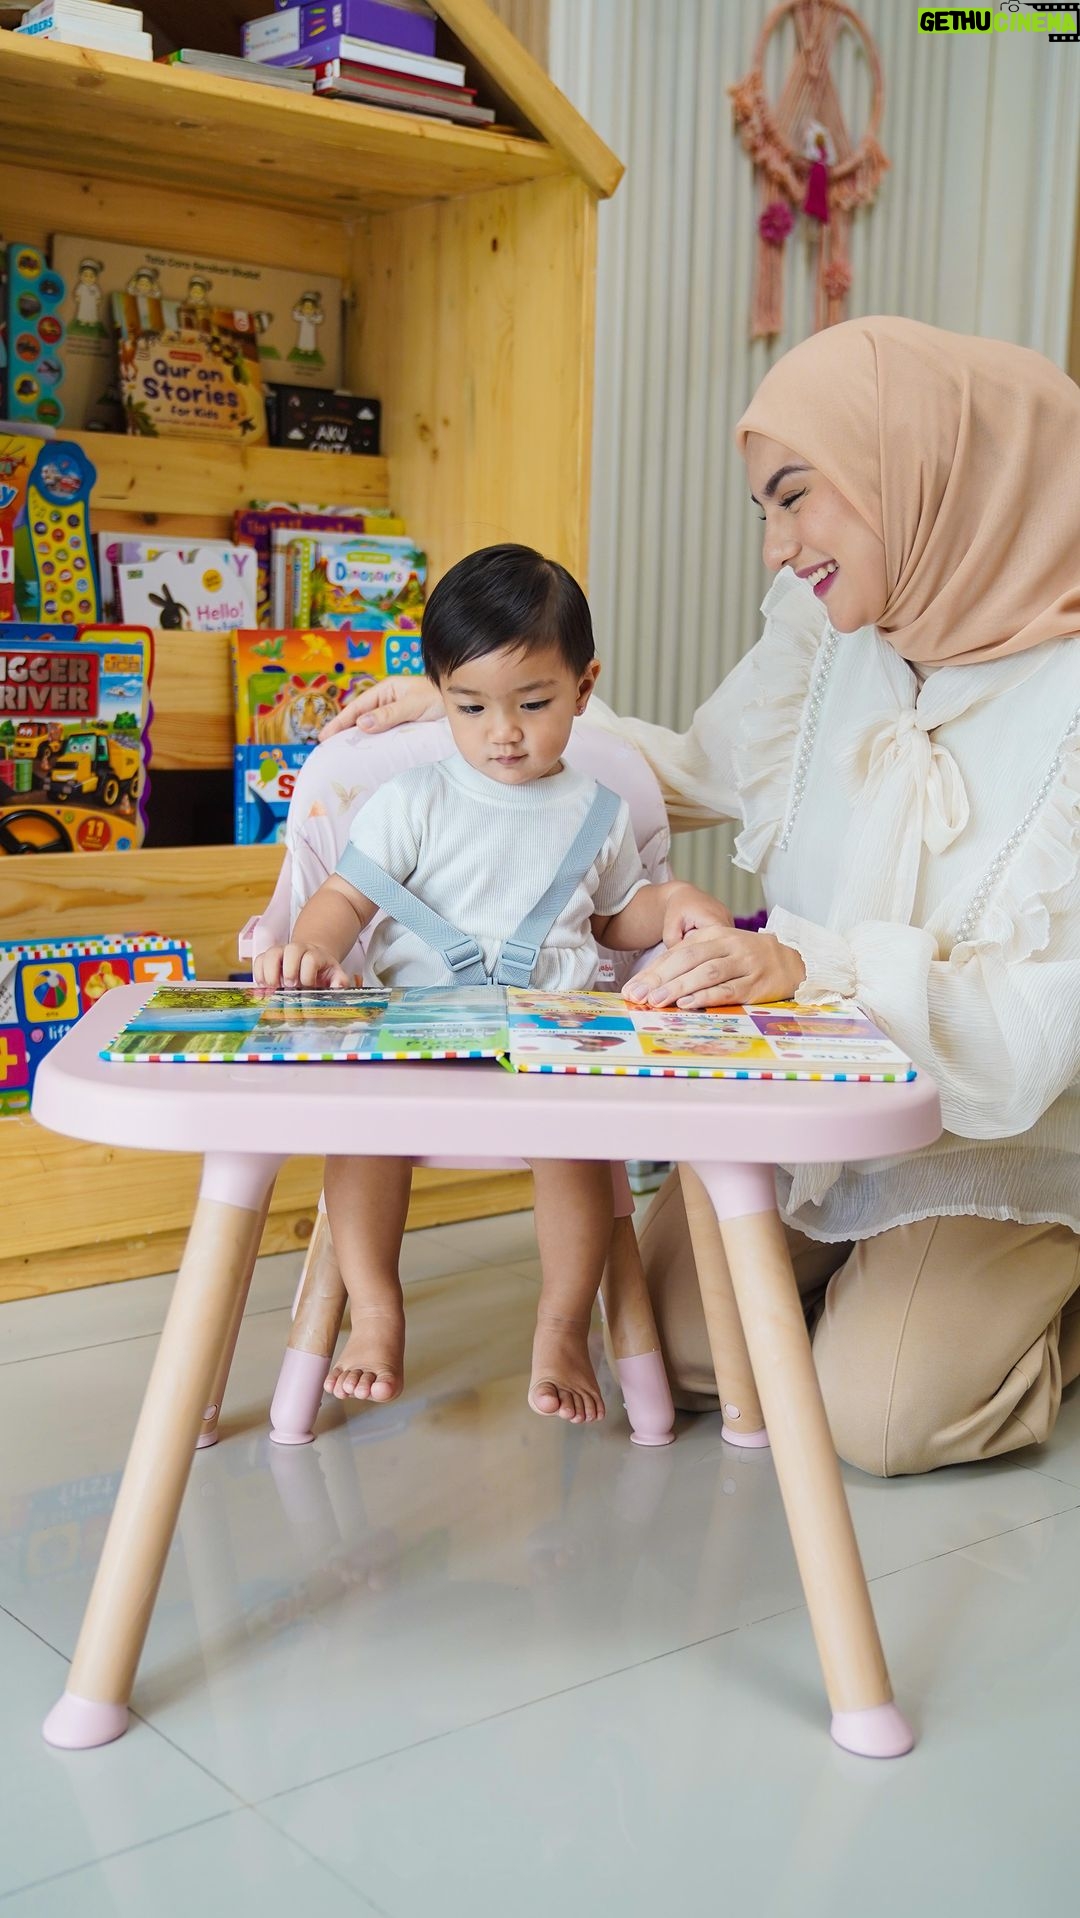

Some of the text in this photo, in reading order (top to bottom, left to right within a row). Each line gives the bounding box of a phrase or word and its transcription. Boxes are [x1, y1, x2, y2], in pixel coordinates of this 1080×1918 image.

[143, 377, 238, 408] Stories
[194, 406, 219, 420] Kids
[315, 424, 348, 442] AKU
[334, 562, 403, 584] Dinosaurs
[196, 602, 245, 622] Hello!
[87, 819, 105, 837] 11
